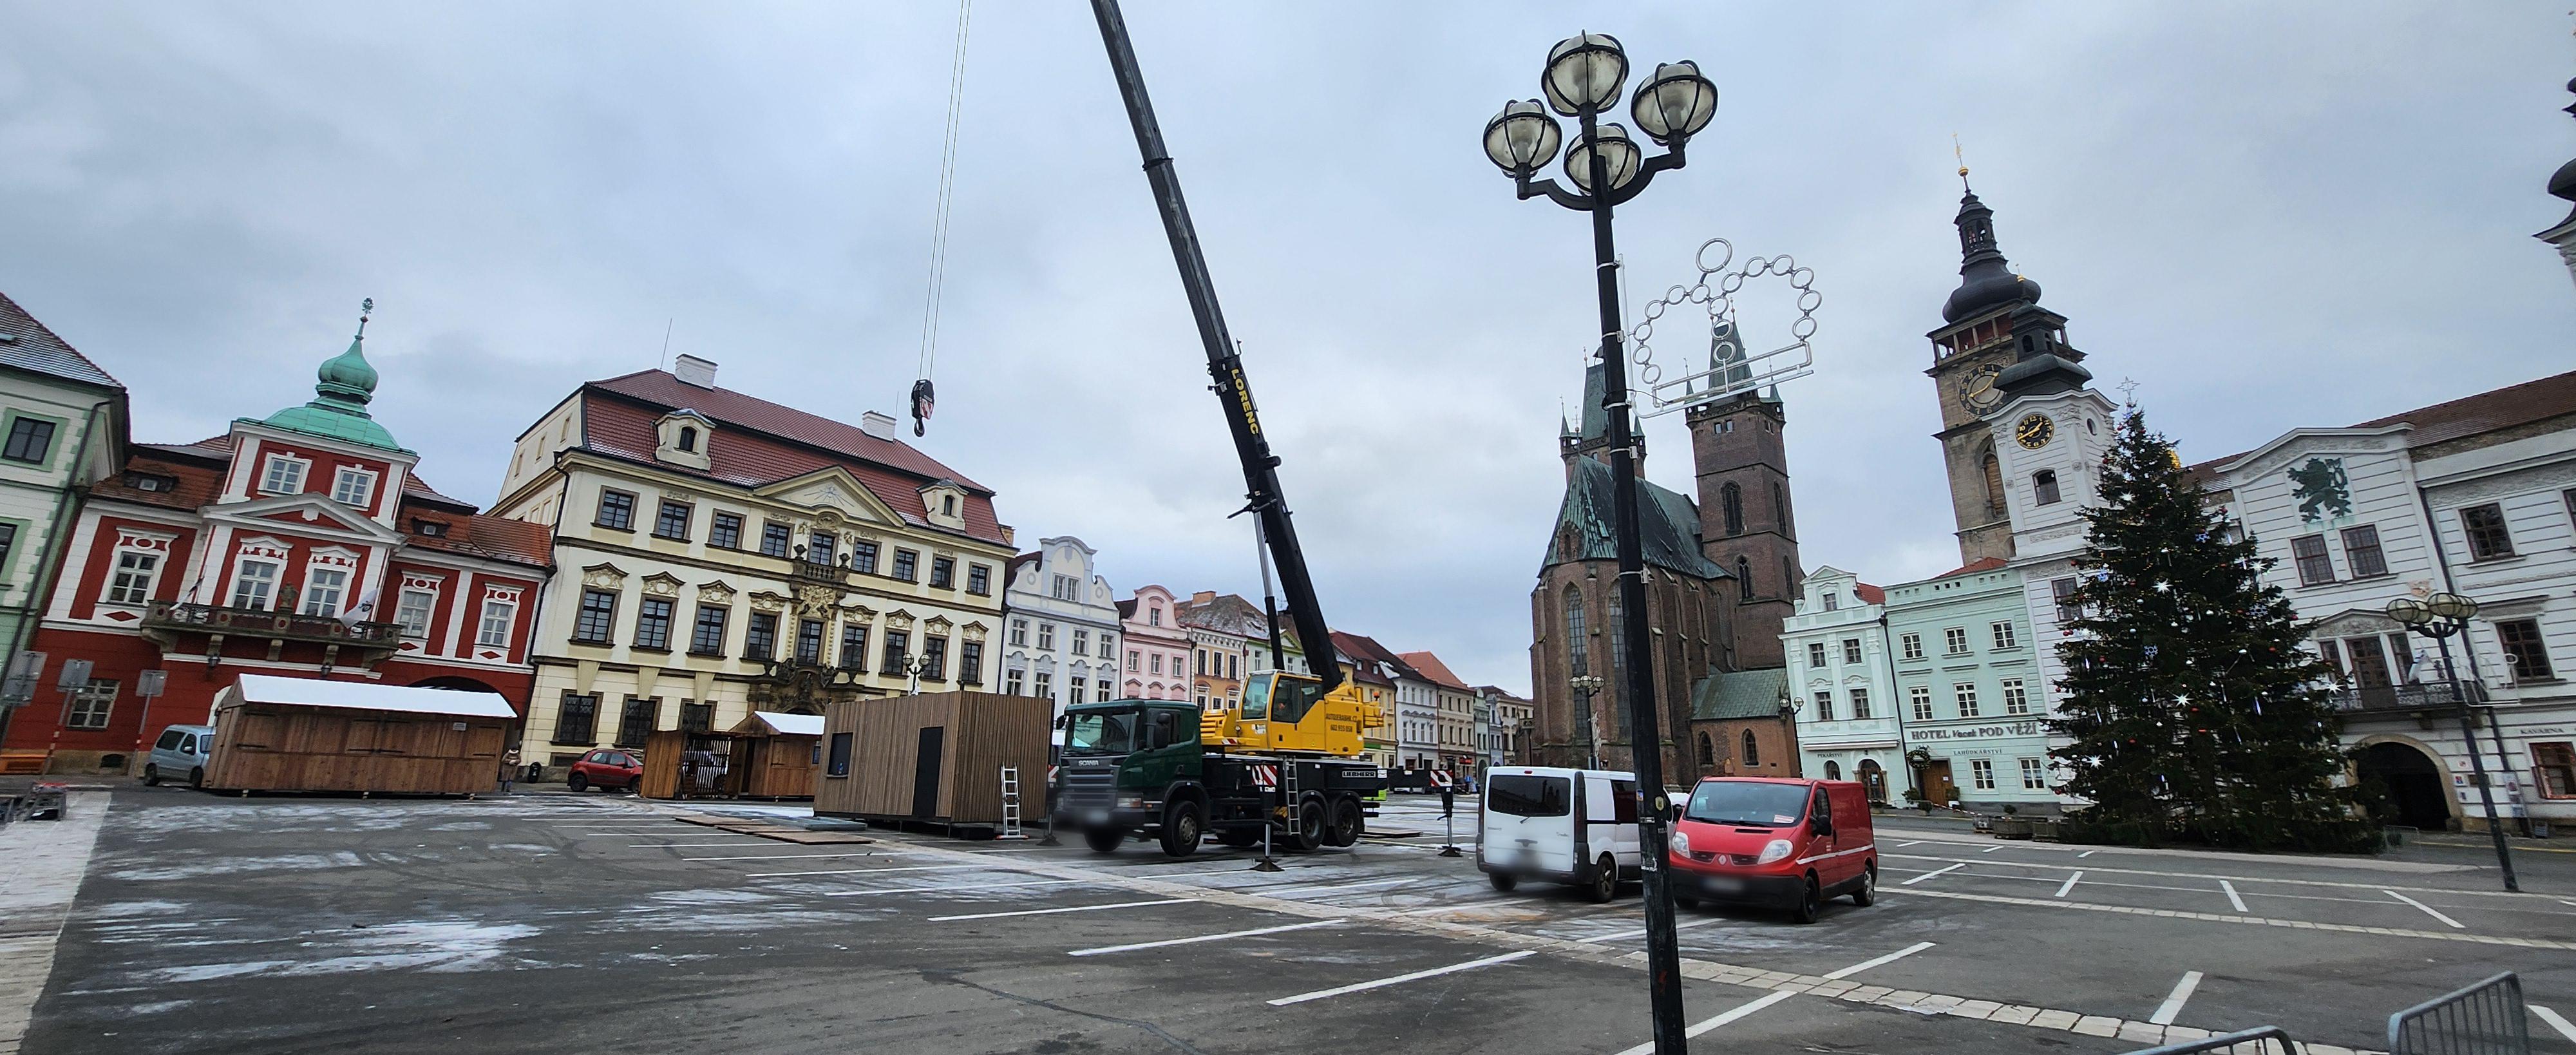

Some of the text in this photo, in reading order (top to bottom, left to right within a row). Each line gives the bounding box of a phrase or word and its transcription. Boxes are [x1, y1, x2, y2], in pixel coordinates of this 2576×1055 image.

[1231, 369, 1258, 435] LORENC
[1911, 730, 1950, 740] HOTEL
[1978, 727, 2004, 737] POD
[2006, 723, 2038, 736] VĚŽÍ
